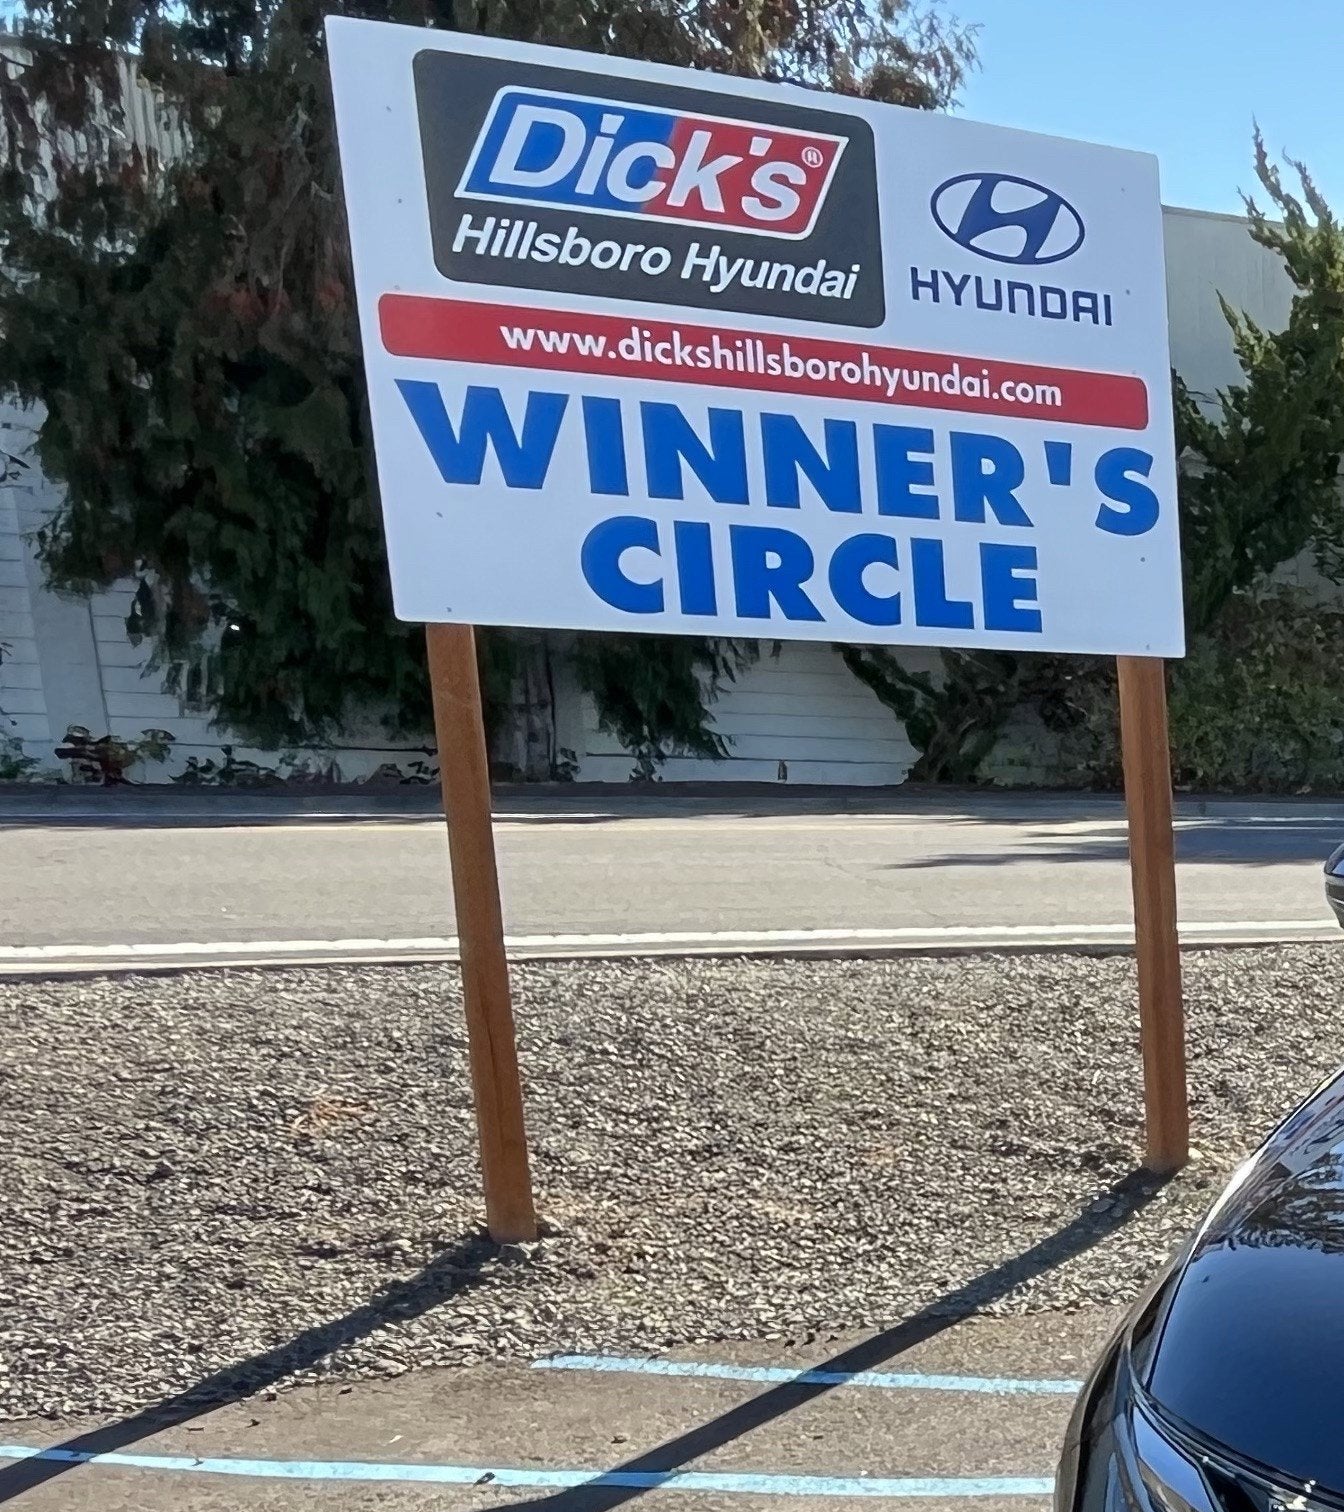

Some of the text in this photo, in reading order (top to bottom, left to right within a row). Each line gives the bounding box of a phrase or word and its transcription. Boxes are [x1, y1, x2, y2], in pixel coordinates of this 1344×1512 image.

[488, 104, 808, 222] Dick's
[452, 213, 860, 299] Hillsboro Hyundai
[910, 266, 1113, 326] HYUNDAI
[500, 324, 1063, 407] www.dickshillsborohyundai.com
[394, 378, 1160, 536] WINNER'S
[580, 516, 1043, 633] CIRCLE
